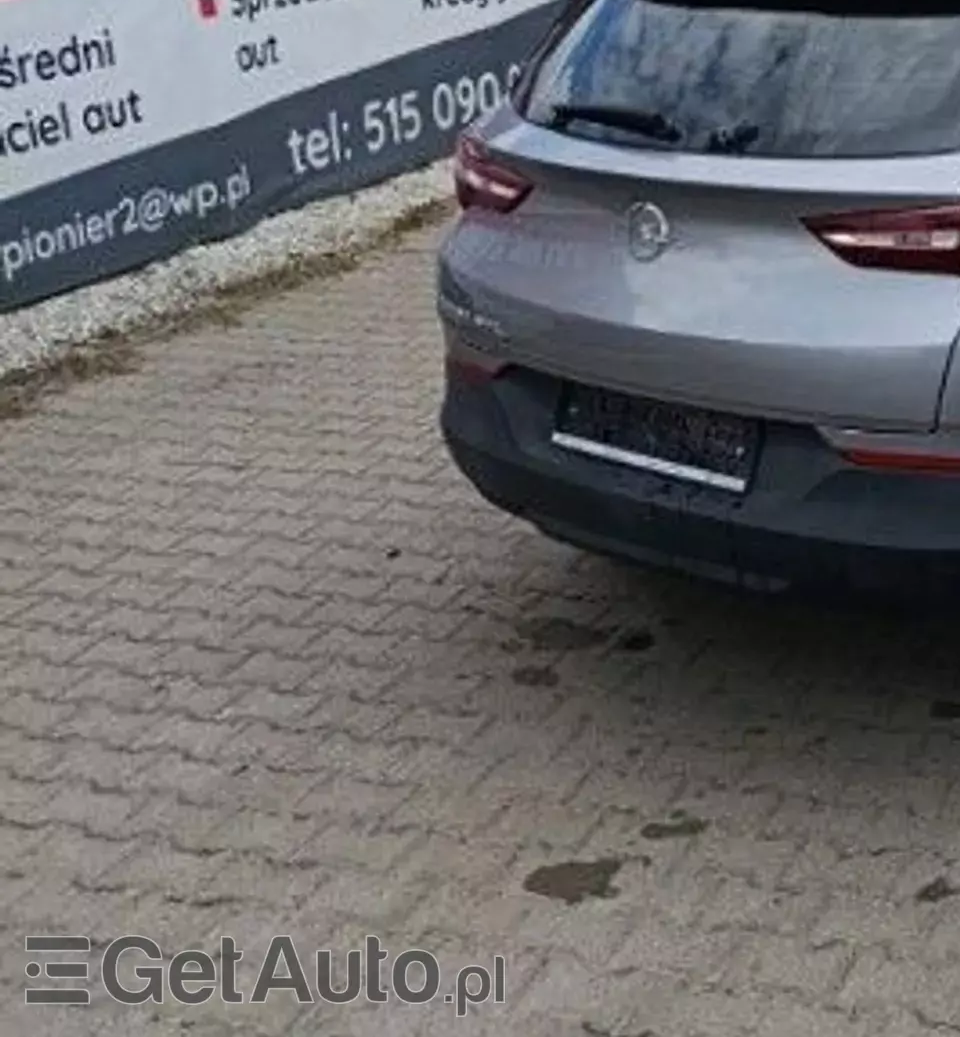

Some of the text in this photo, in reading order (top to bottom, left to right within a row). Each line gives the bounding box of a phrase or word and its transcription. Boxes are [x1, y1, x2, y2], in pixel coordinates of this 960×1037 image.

[235, 35, 280, 73] aut
[82, 88, 143, 135] aut
[286, 109, 353, 175] tel:
[362, 88, 422, 154] 515
[1, 163, 252, 282] pionier2@wp.pl
